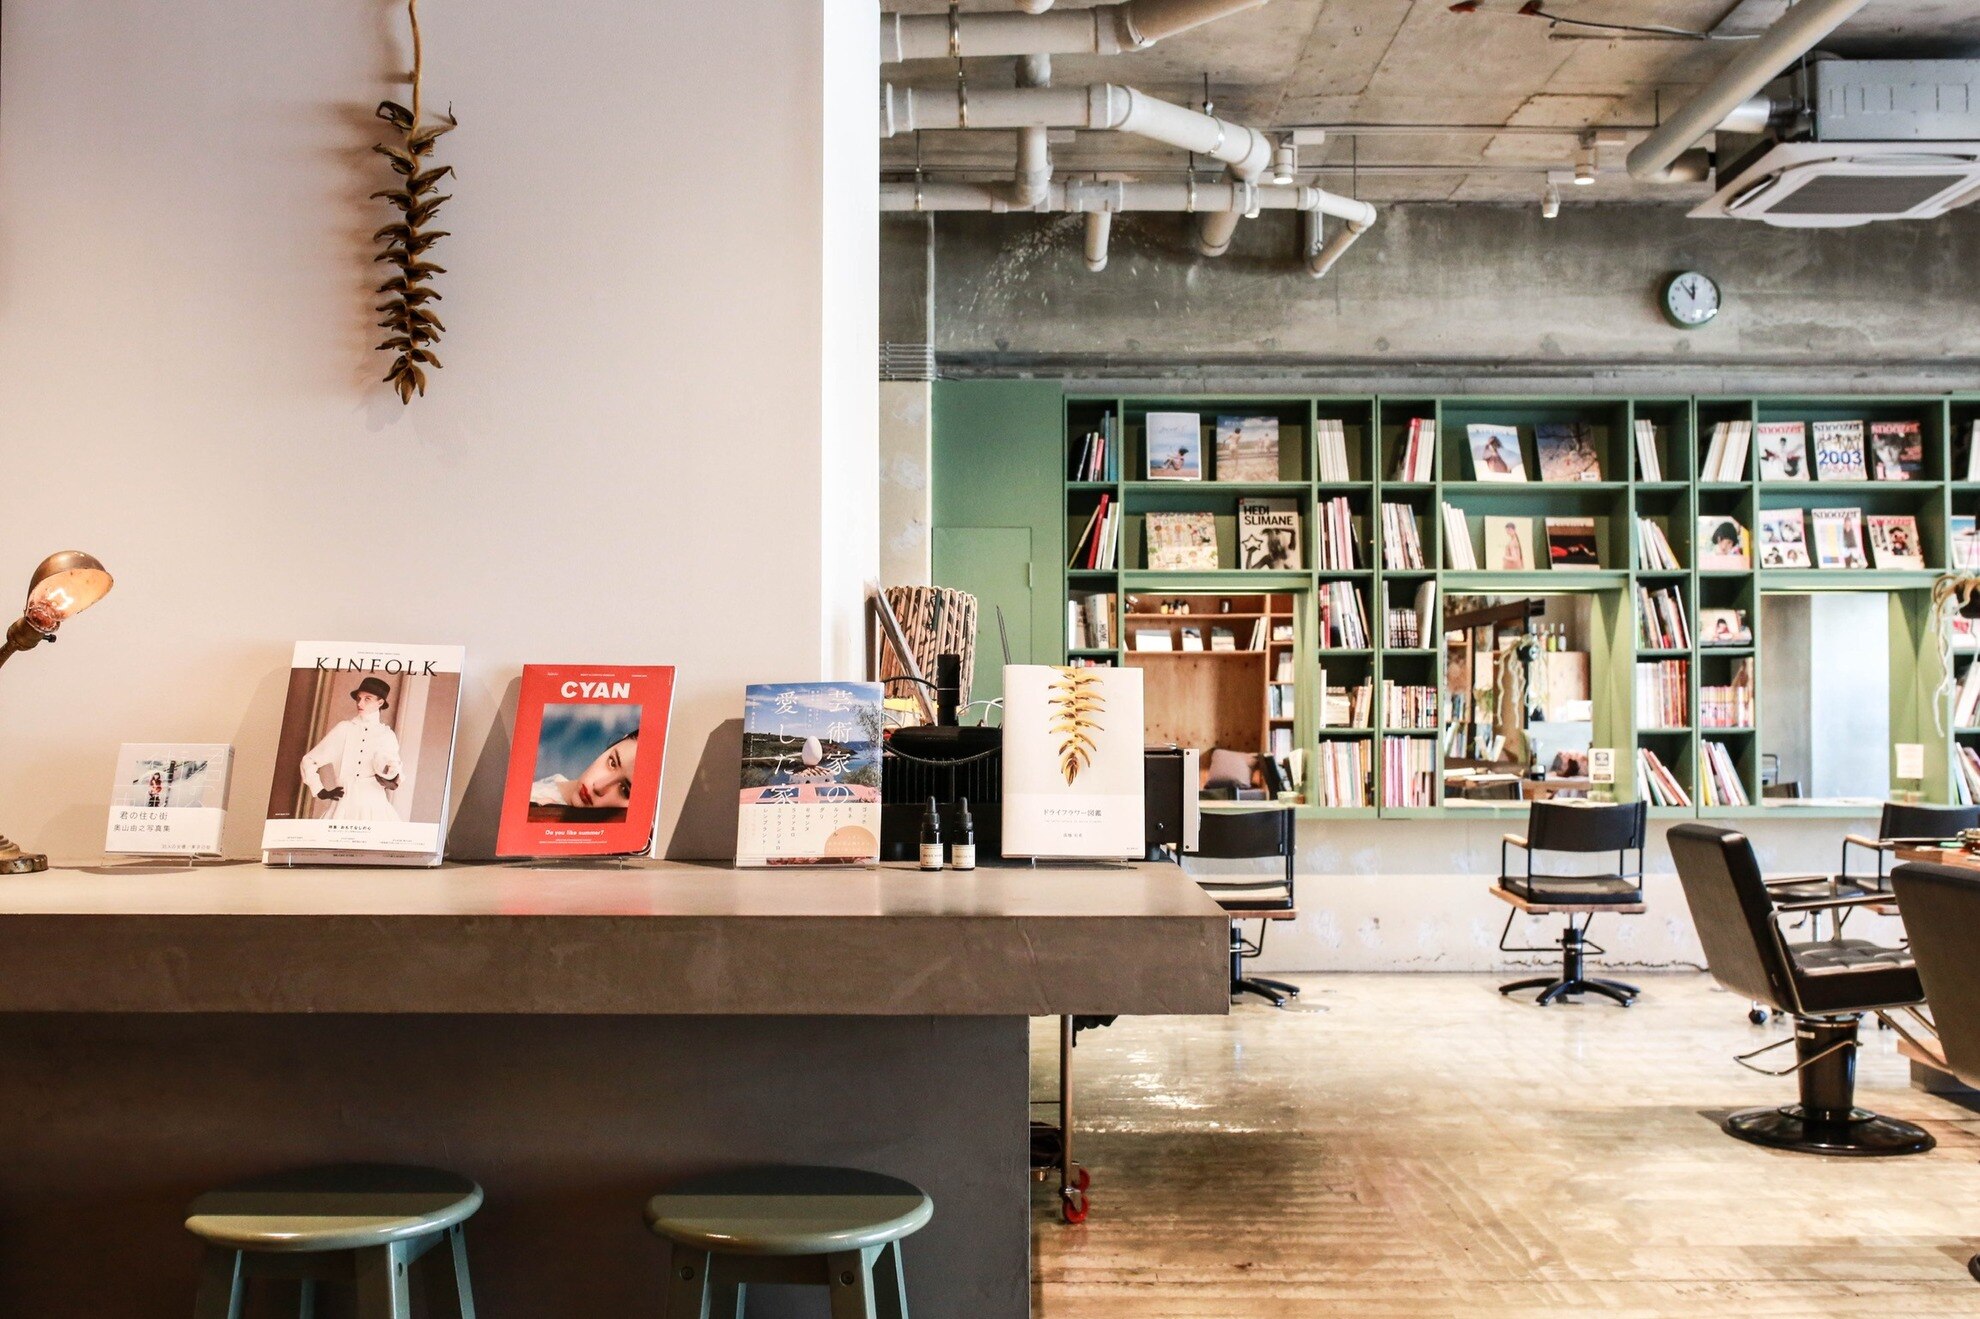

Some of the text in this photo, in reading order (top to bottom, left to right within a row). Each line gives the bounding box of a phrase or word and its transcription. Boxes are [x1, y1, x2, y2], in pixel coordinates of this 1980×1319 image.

[1818, 450, 1862, 466] 2003
[1243, 505, 1270, 515] HEDI
[1244, 515, 1294, 526] SLIMANE
[315, 657, 438, 677] KINFOLK
[560, 681, 631, 699] CYAN
[770, 690, 799, 805] 愛した家
[826, 689, 855, 805] 芸術家の
[120, 811, 168, 820] 君の住む街
